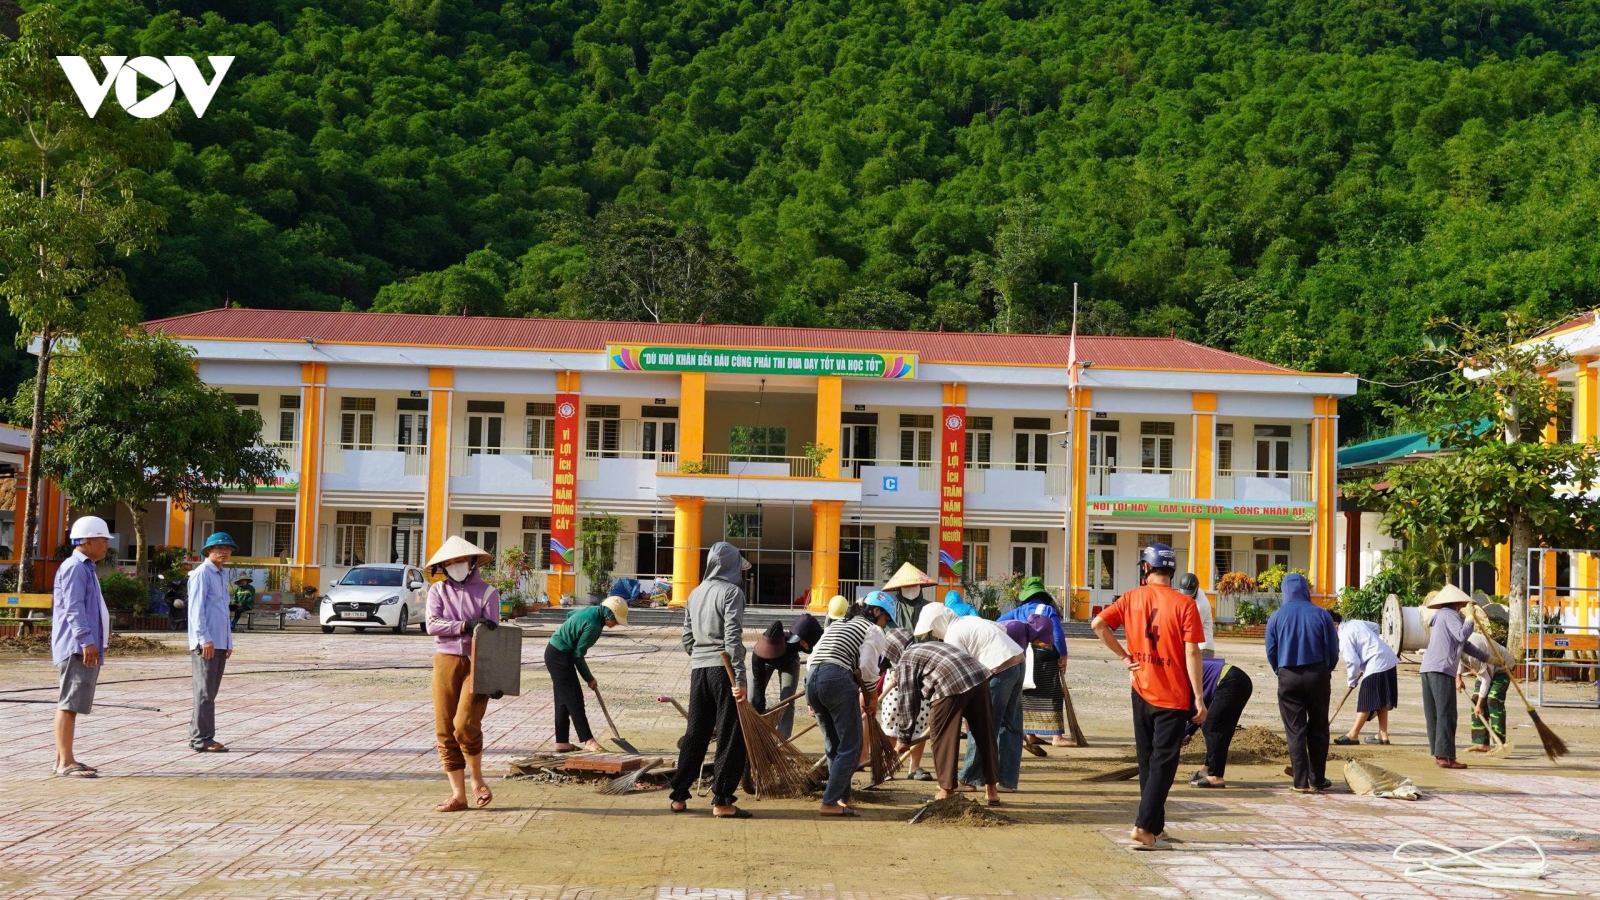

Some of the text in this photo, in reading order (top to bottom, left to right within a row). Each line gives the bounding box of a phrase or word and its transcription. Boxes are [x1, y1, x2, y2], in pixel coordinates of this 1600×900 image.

[773, 357, 785, 369] THI
[885, 478, 896, 490] C
[1131, 503, 1149, 512] HAY
[1145, 608, 1160, 650] 4
